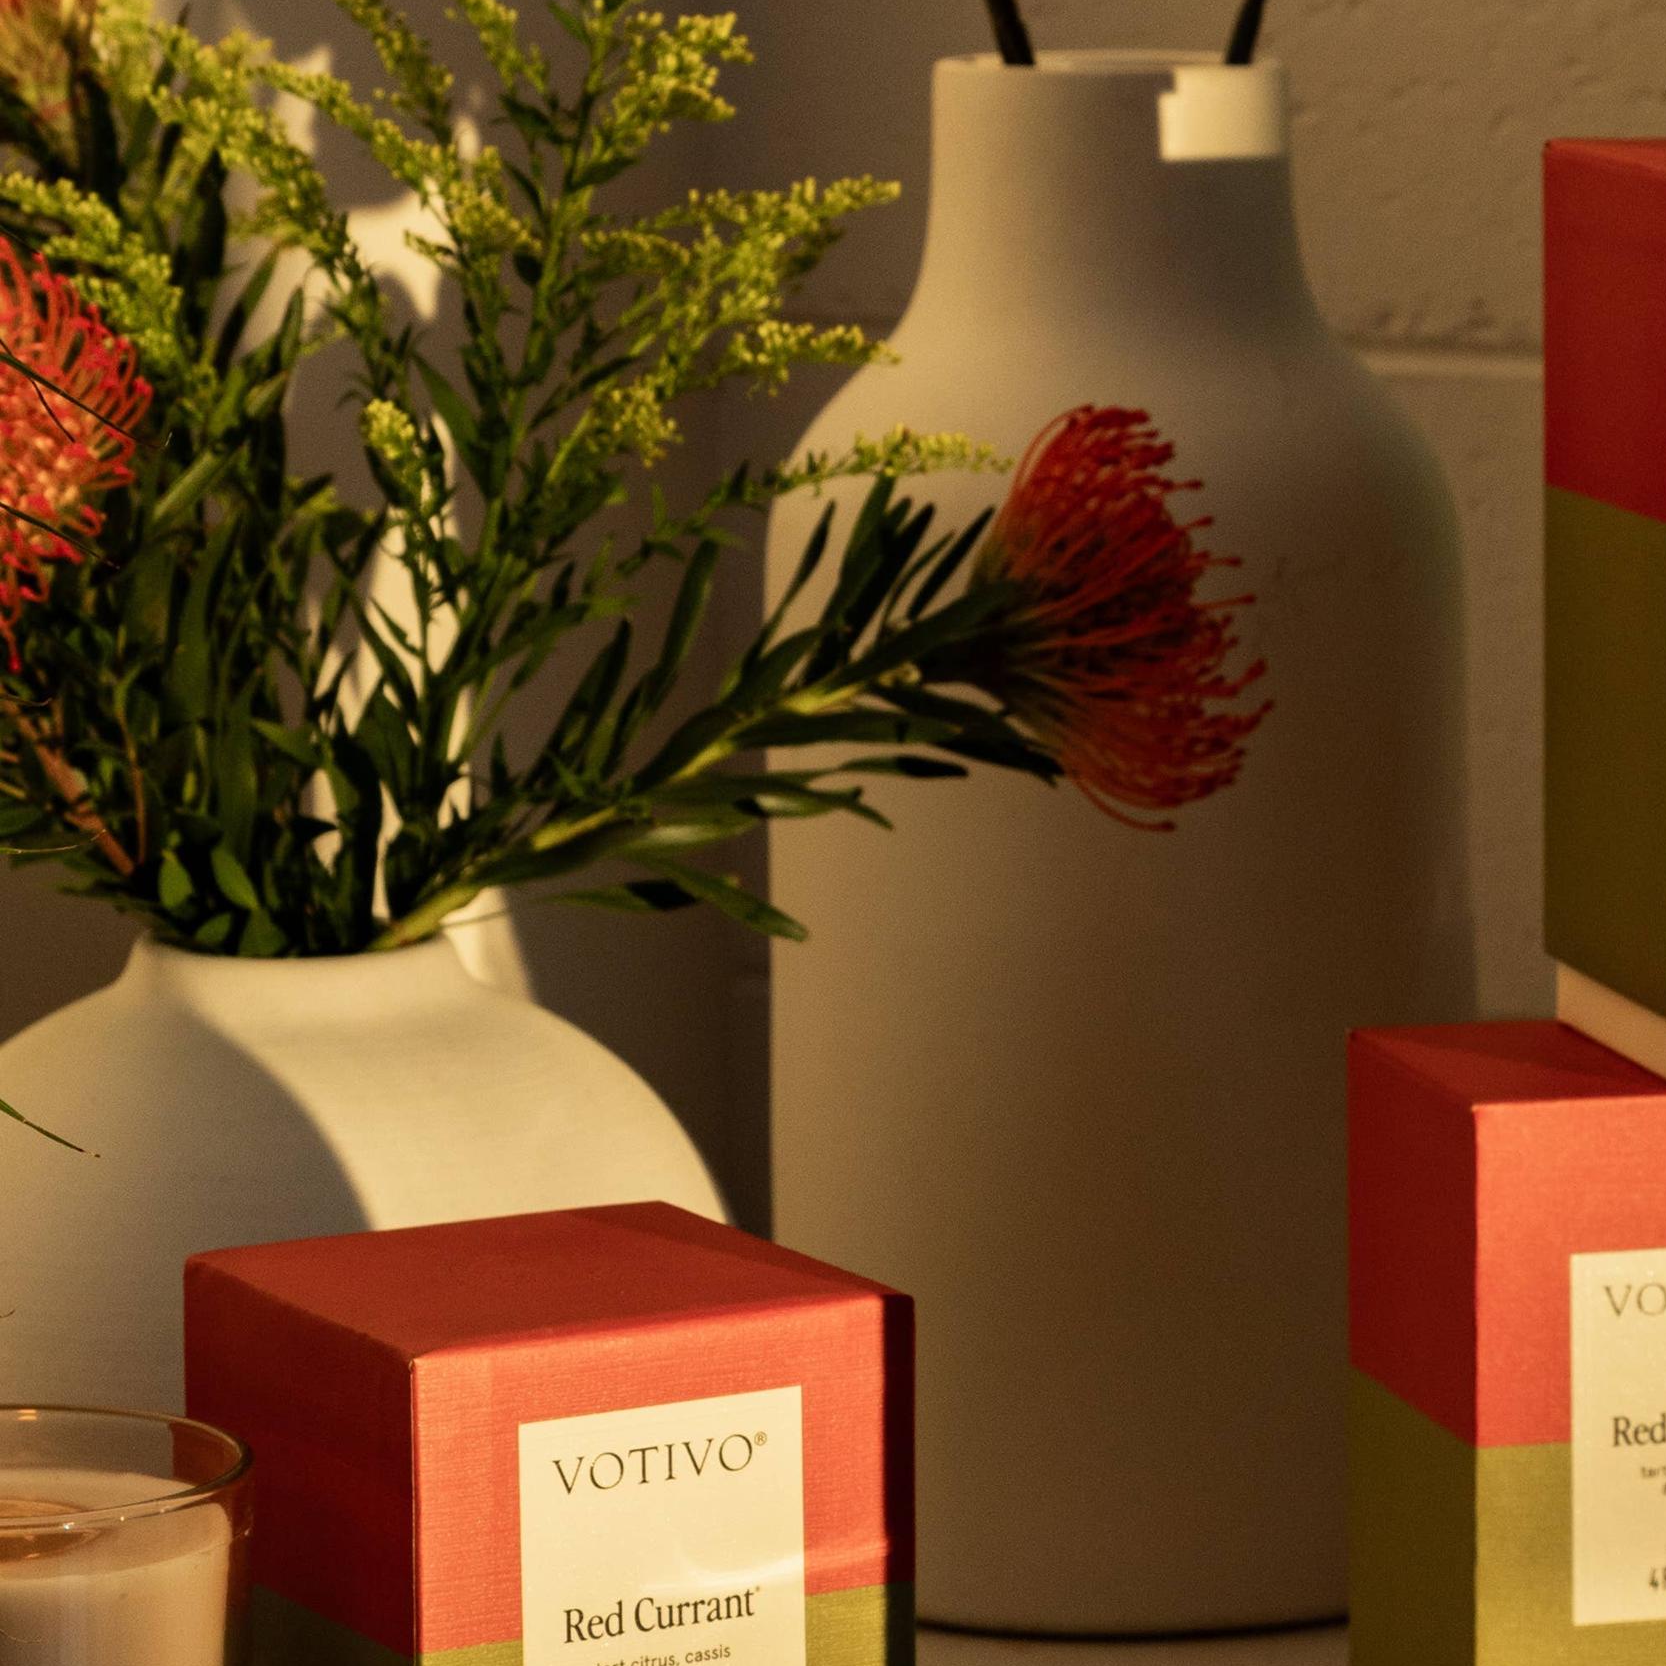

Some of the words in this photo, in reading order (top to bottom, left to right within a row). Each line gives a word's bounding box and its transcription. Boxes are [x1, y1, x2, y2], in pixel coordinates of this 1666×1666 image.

[1648, 1566, 1658, 1591] 4
[563, 1599, 624, 1644] Red
[634, 1588, 756, 1634] Currant
[684, 1643, 731, 1664] cassis
